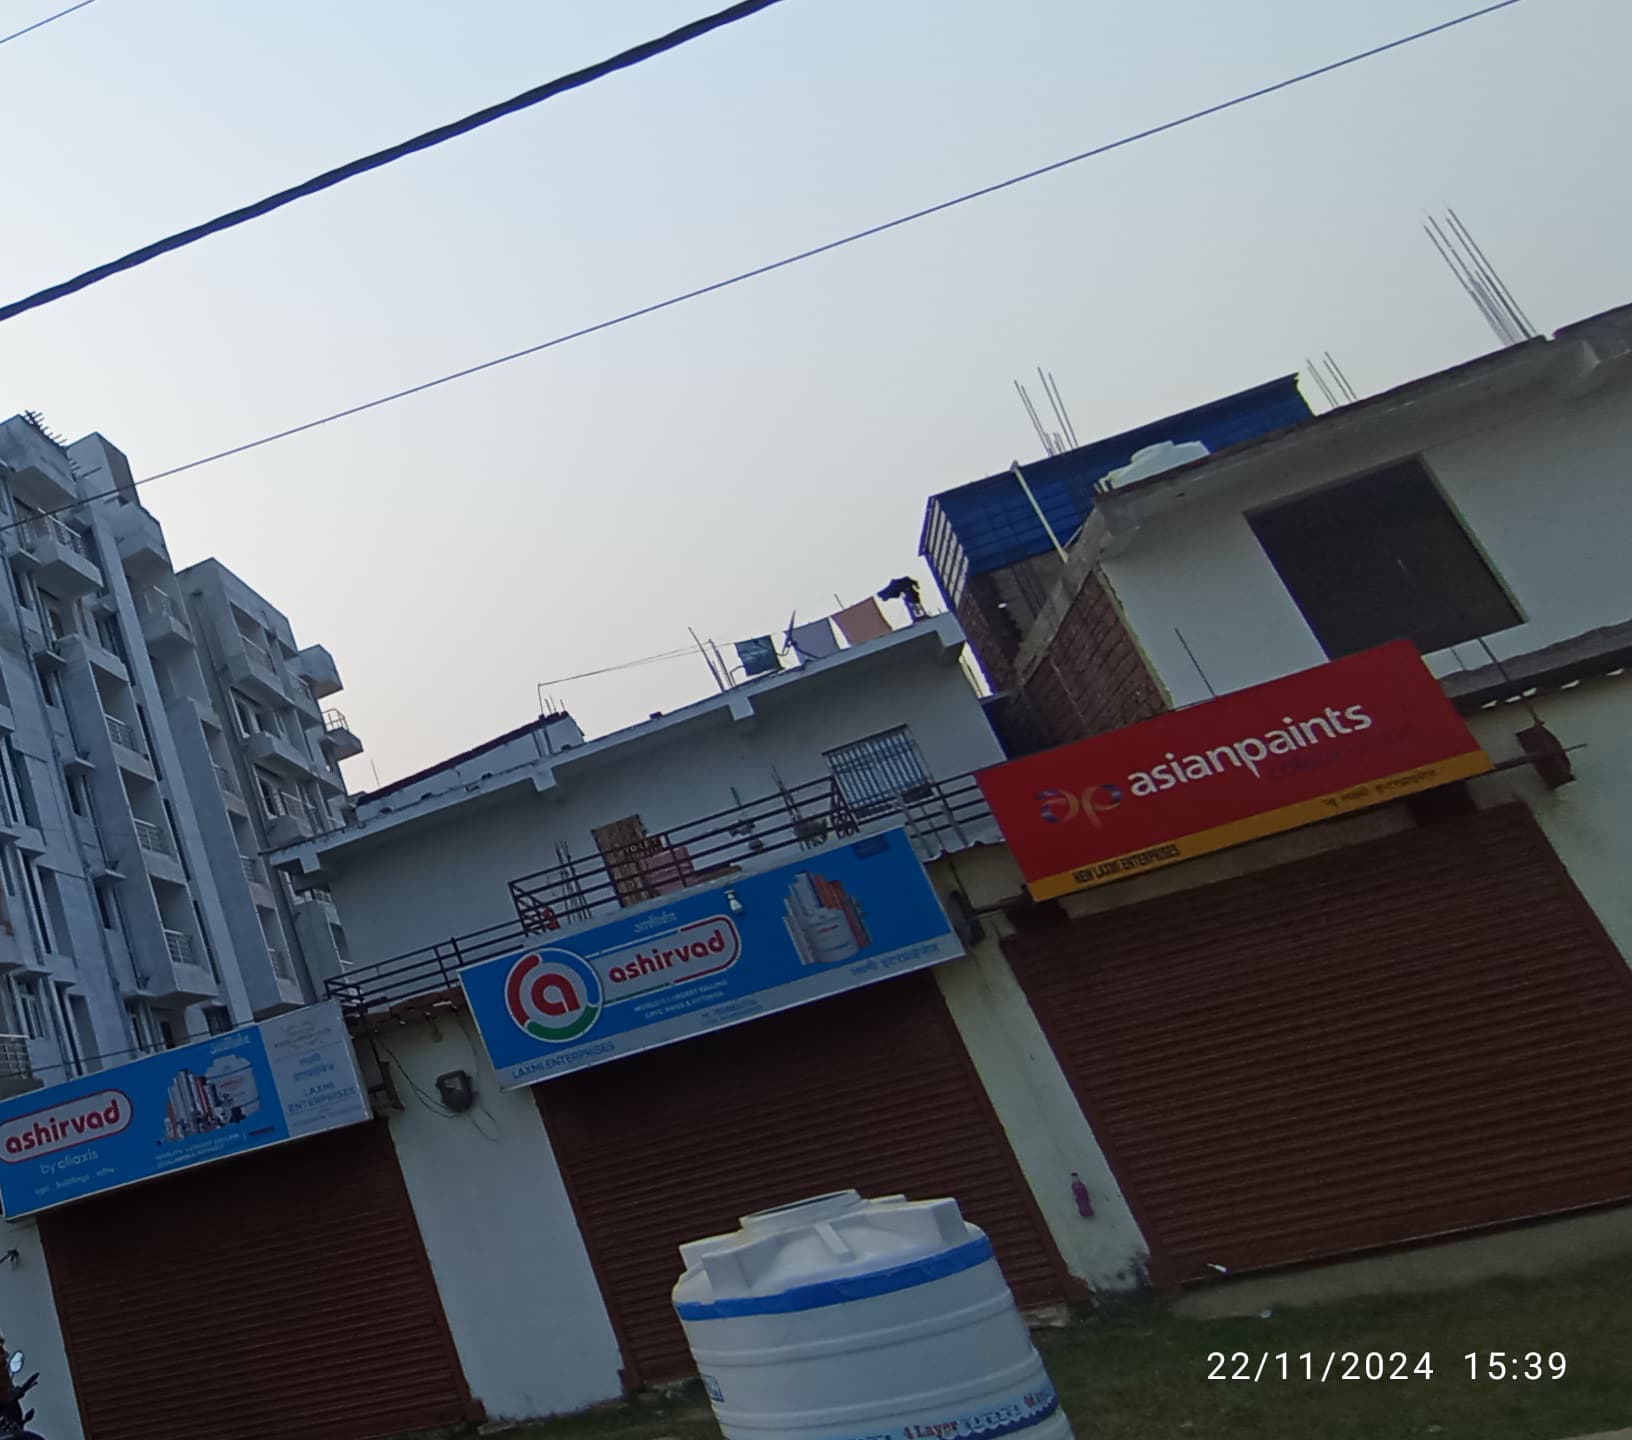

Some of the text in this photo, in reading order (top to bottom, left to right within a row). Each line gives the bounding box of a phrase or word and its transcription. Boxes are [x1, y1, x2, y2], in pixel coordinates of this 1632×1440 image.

[1074, 868, 1095, 883] NEW
[1119, 844, 1180, 870] ENTERPRISES
[609, 929, 725, 983] ashirvad
[543, 1040, 615, 1068] ENTERPRISES
[5, 1099, 121, 1154] ashirvad
[40, 1163, 56, 1176] by
[903, 1426, 914, 1439] 4
[916, 1421, 960, 1440] Layer
